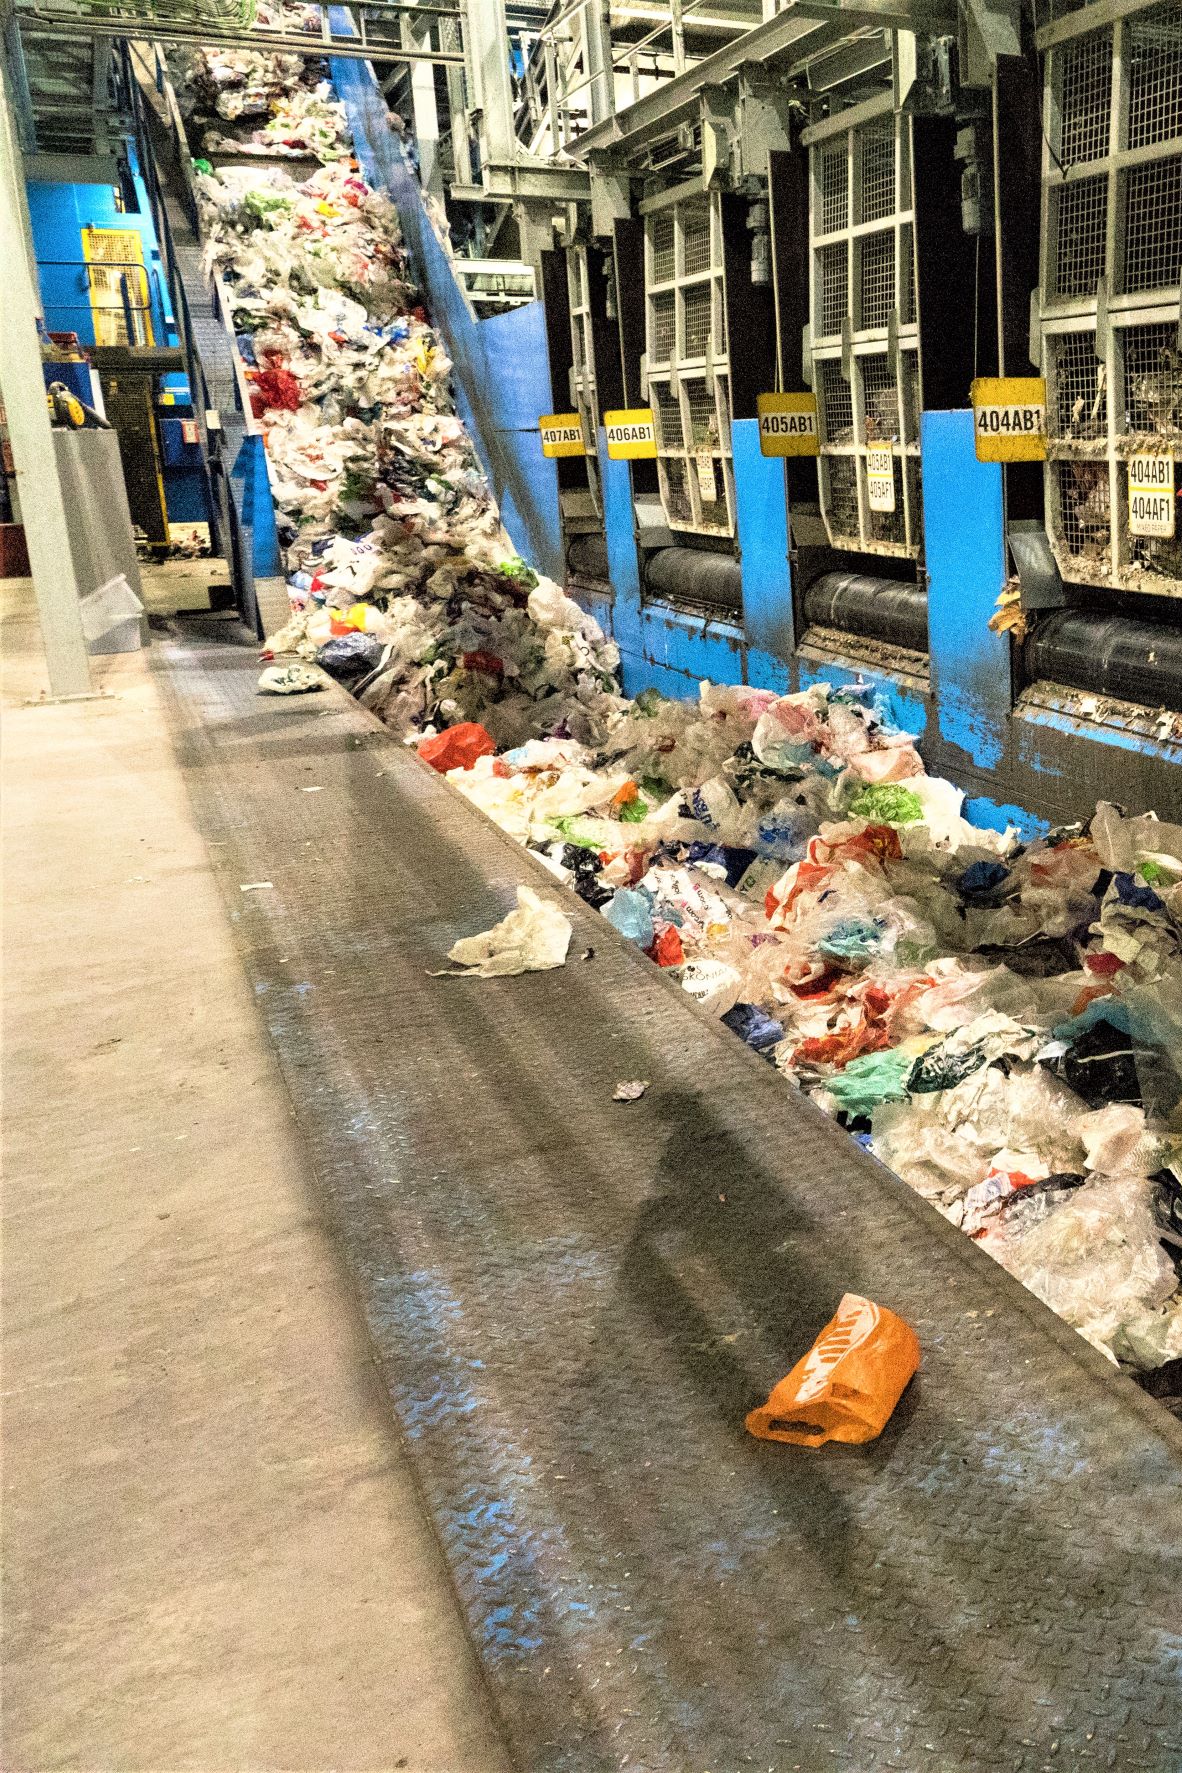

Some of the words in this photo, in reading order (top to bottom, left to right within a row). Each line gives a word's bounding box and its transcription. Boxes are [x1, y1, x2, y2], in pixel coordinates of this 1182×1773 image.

[762, 416, 813, 433] 405AB1
[978, 409, 1041, 432] 404AB1
[543, 429, 581, 442] 407AB1
[608, 427, 651, 441] 406AB1
[867, 453, 891, 471] 405AB1
[1131, 460, 1170, 484] 404AB1
[870, 481, 892, 499] 405AF1
[1131, 496, 1170, 521] 404AF1
